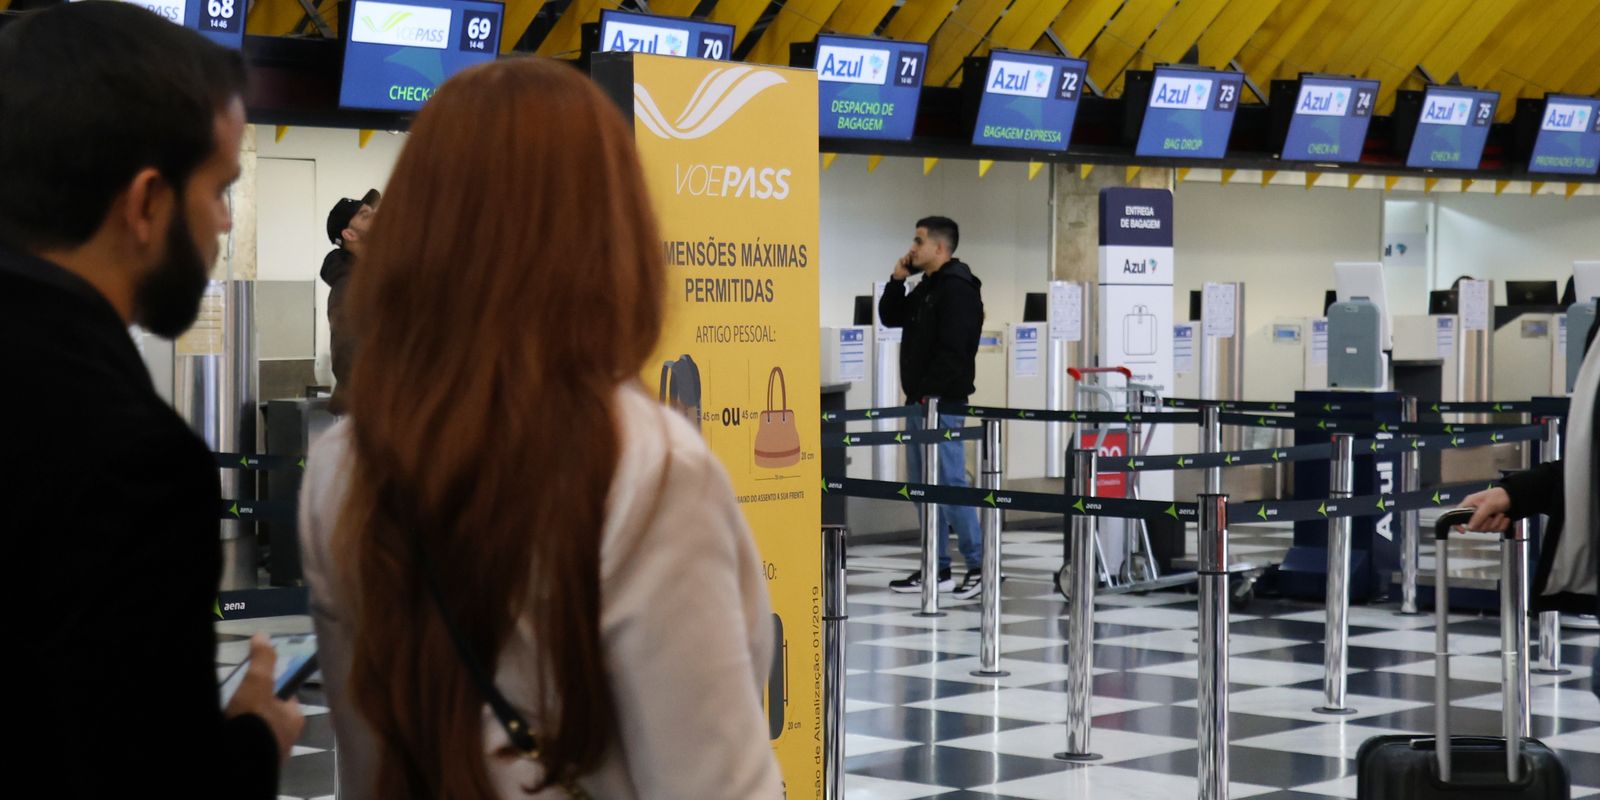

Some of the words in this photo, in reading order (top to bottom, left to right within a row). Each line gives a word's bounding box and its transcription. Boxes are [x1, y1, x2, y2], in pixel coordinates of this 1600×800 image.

[147, 4, 180, 20] PASS
[208, 0, 234, 18] 68
[468, 17, 491, 39] 69
[609, 29, 658, 54] Azul
[703, 39, 723, 60] 70
[821, 53, 864, 78] Azul
[901, 57, 918, 76] 71
[992, 67, 1030, 91] Azul
[1062, 72, 1078, 91] 72
[389, 85, 437, 101] CHECK-
[1156, 83, 1191, 104] Azul
[1219, 85, 1235, 102] 73
[1302, 91, 1332, 111] Azul
[1357, 93, 1371, 109] 74
[831, 101, 880, 115] DESPACHO
[881, 104, 894, 115] DE
[1425, 101, 1455, 120] Azul
[1478, 103, 1491, 118] 75
[838, 117, 883, 130] BAGAGEM
[1546, 109, 1575, 128] Azul
[984, 126, 1024, 139] BAGAGEM
[1025, 128, 1062, 142] EXPRESSA
[1164, 138, 1180, 149] BAG
[1181, 139, 1203, 150] DROP
[676, 163, 791, 200] VOEPASS
[1125, 206, 1154, 216] ENTREGA
[1120, 218, 1130, 228] DE
[1130, 219, 1160, 229] BAGAGEM
[663, 236, 737, 267] MENSÕES
[741, 237, 808, 268] MÁXIMAS
[1123, 259, 1146, 274] Azul
[685, 278, 774, 303] PERMITIDAS
[696, 325, 732, 343] ARTIGO
[733, 325, 776, 343] PESSOAL:
[722, 407, 740, 427] ou
[1376, 462, 1393, 541] Aul
[224, 602, 245, 611] aena
[813, 653, 822, 741] Atualização
[814, 746, 821, 764] de
